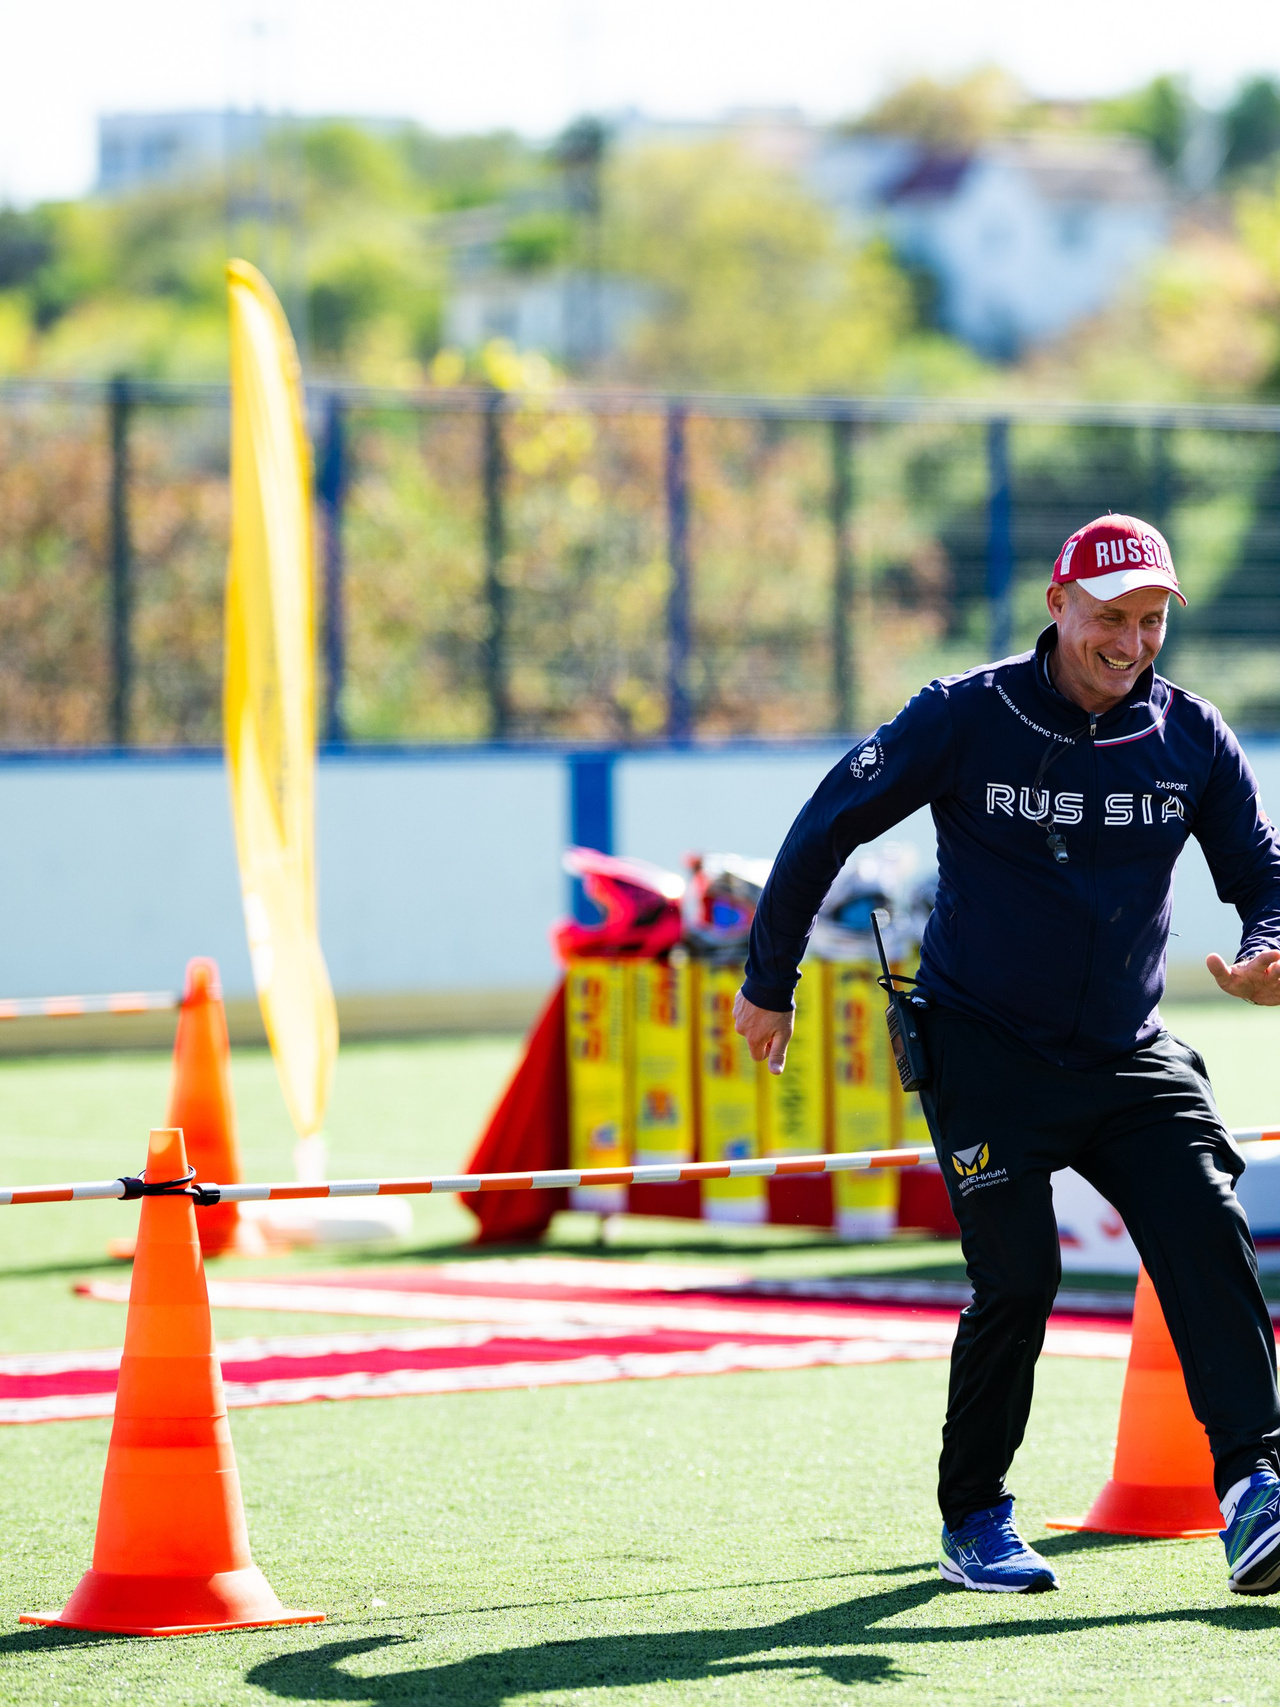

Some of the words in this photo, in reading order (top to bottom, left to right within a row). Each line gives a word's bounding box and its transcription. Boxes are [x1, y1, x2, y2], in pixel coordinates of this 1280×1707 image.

[1095, 537, 1171, 573] RUSSIA
[995, 684, 1021, 715] RUSSIAN
[1019, 714, 1051, 738] OLYMPIC
[1053, 733, 1076, 745] TEAM
[1155, 780, 1188, 792] ZASPORT
